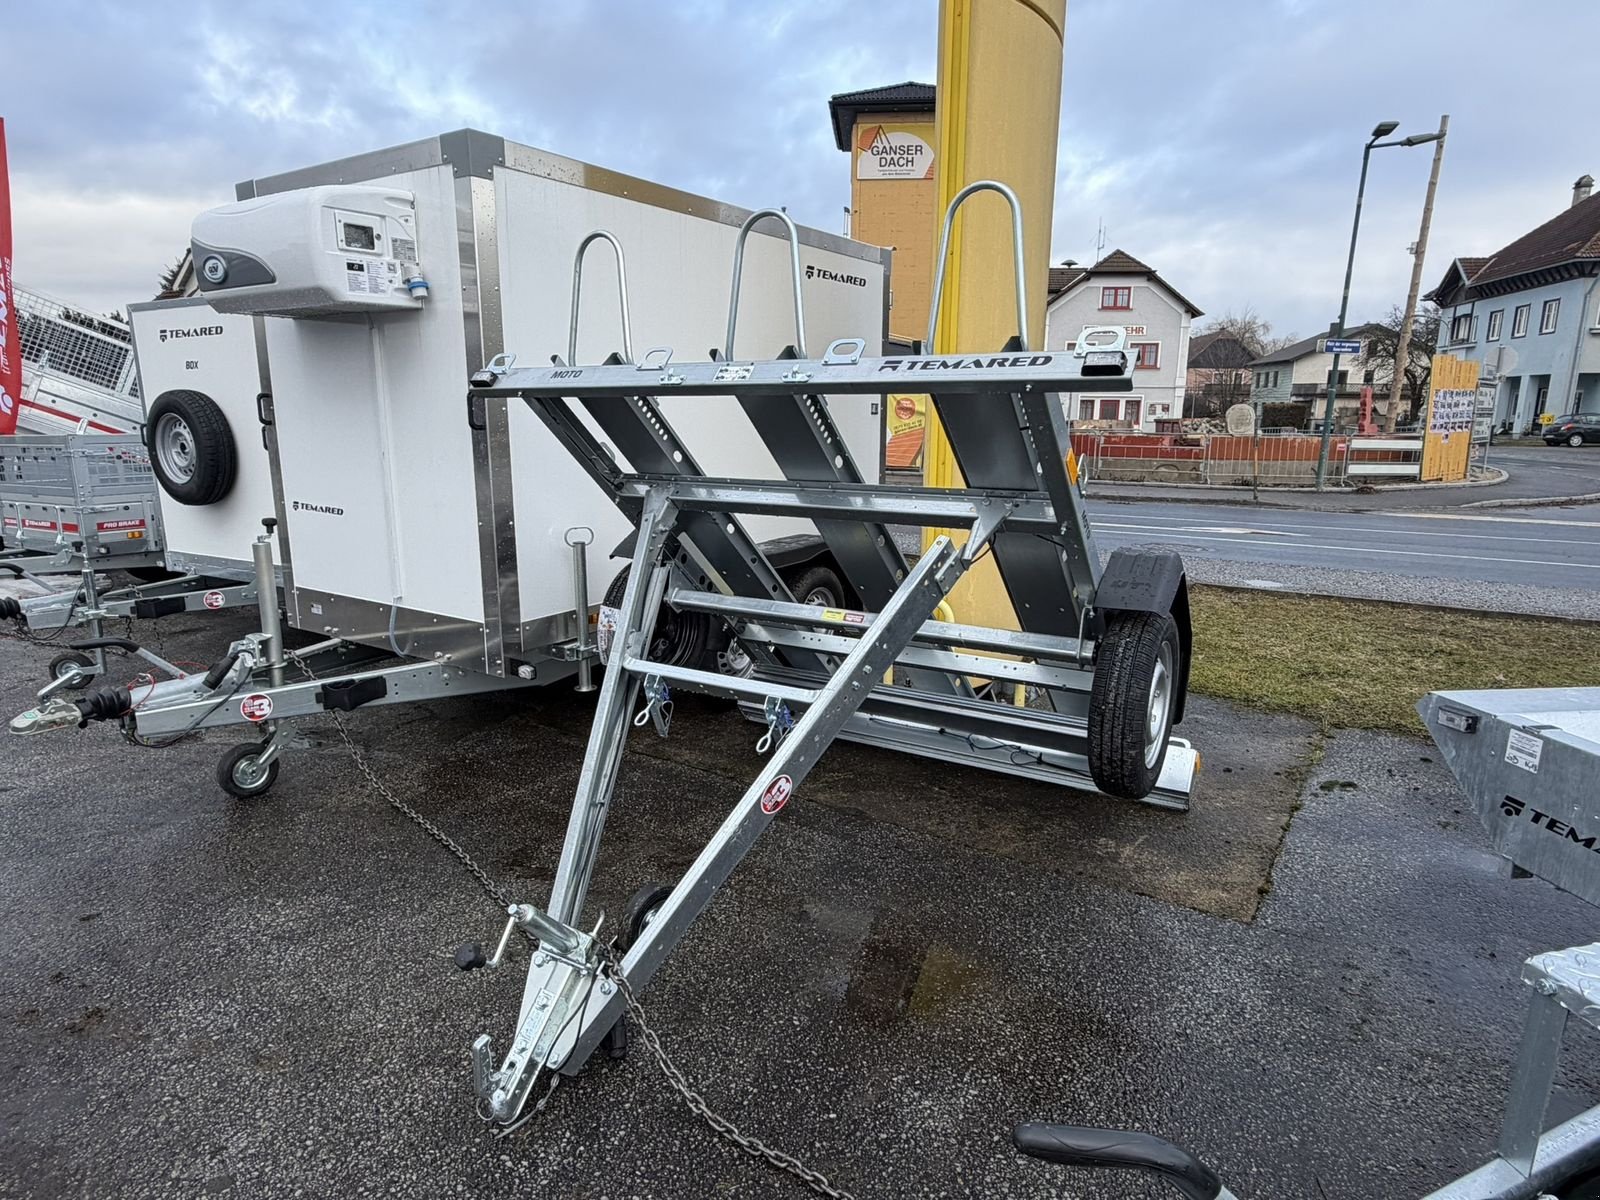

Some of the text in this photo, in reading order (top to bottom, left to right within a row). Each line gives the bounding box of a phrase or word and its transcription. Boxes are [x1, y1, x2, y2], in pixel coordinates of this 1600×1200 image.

[871, 145, 923, 156] GANSER
[879, 157, 914, 167] DACH
[816, 268, 866, 287] TEMARED
[169, 326, 223, 338] TEMARED
[185, 361, 199, 370] BOX
[907, 355, 1053, 371] TEMARED
[550, 370, 583, 379] MOTO
[300, 502, 344, 516] TEMARED
[103, 520, 140, 529] PRO BRAKE
[1530, 808, 1600, 855] TEM
